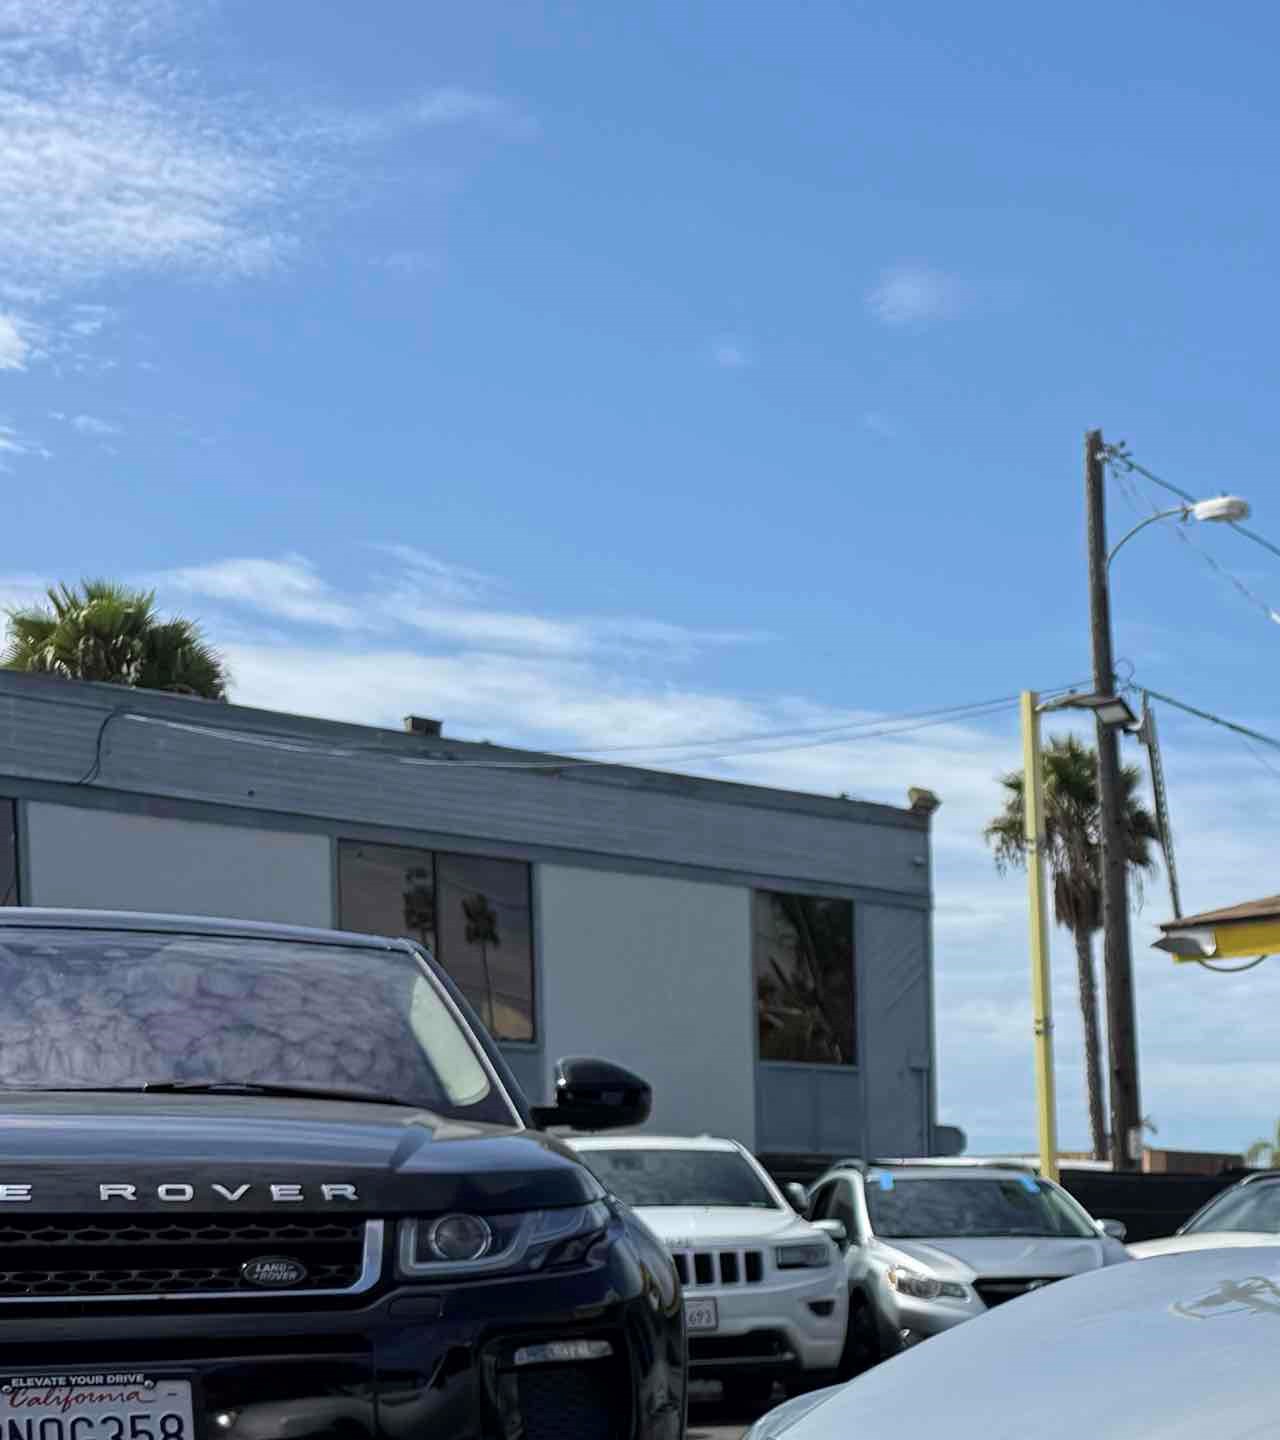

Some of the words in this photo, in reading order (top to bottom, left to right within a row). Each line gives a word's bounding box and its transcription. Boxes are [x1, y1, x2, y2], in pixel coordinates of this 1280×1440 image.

[99, 1183, 360, 1202] ROVER
[11, 1376, 67, 1388] ELEVATE
[70, 1375, 104, 1386] YOUR
[107, 1373, 145, 1384] DRIVE
[8, 1388, 146, 1413] California
